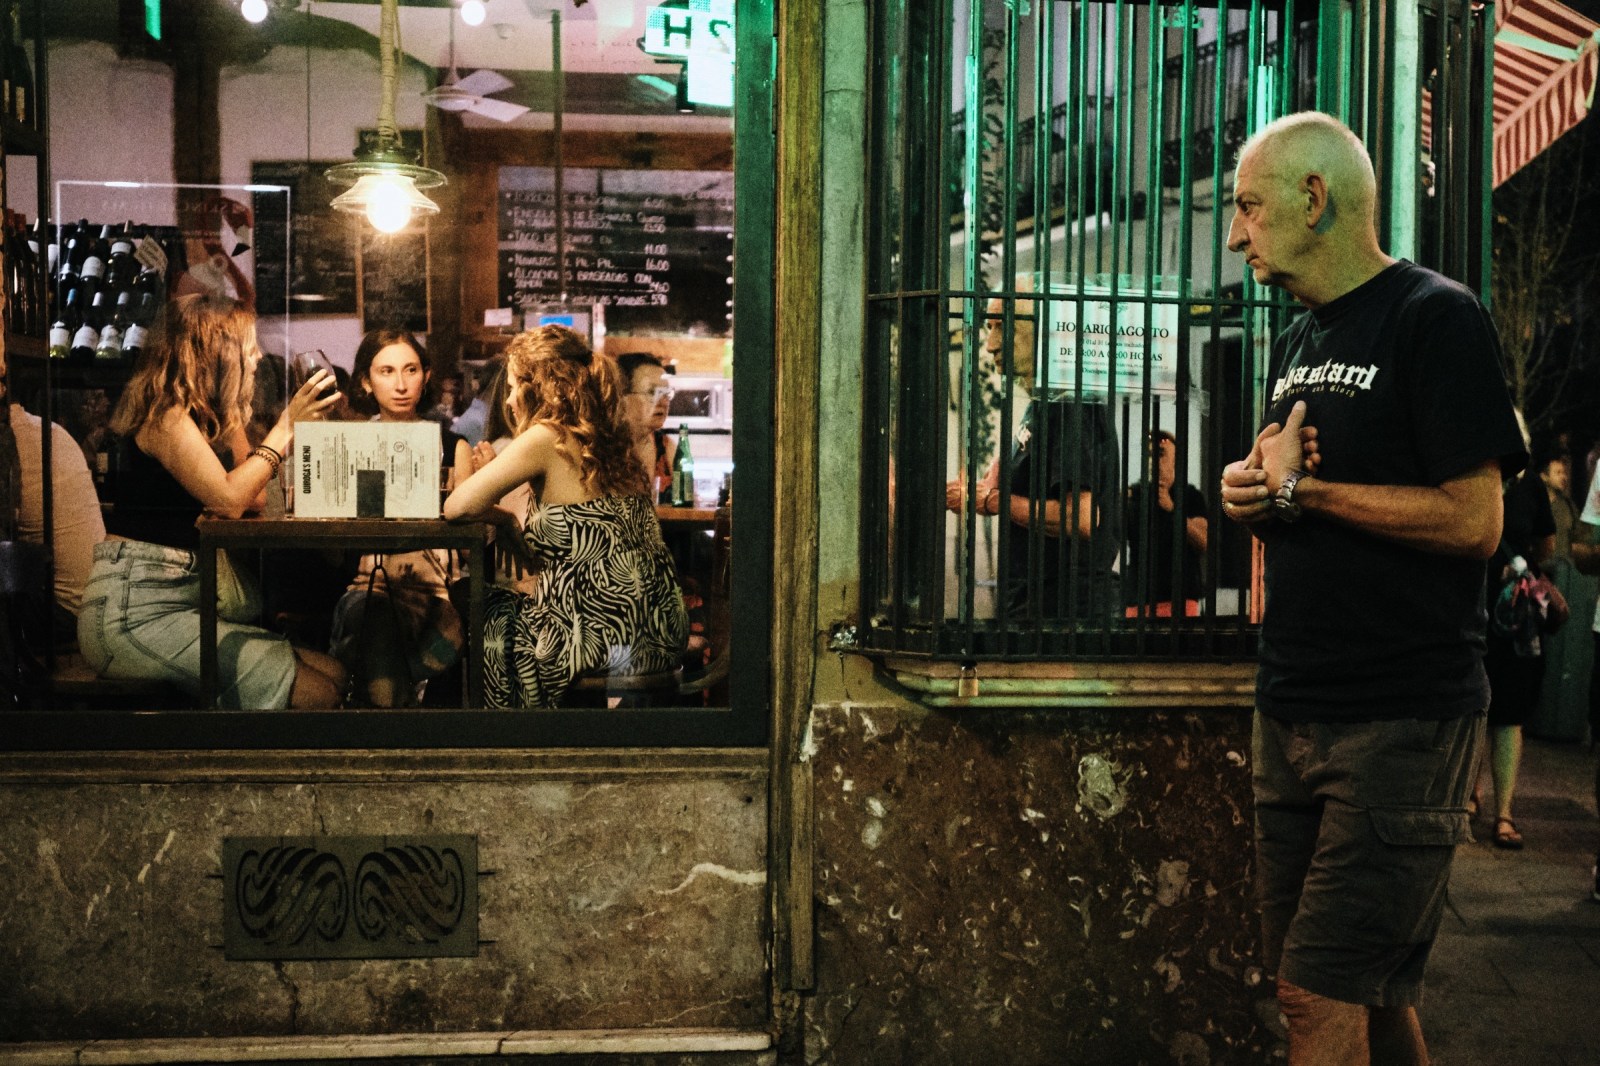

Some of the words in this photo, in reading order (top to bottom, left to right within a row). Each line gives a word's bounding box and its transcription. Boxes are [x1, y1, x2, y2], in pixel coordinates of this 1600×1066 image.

[1116, 325, 1169, 339] AGOTO
[1060, 347, 1074, 356] DE
[1129, 352, 1163, 361] HOAS
[302, 445, 311, 462] MENU
